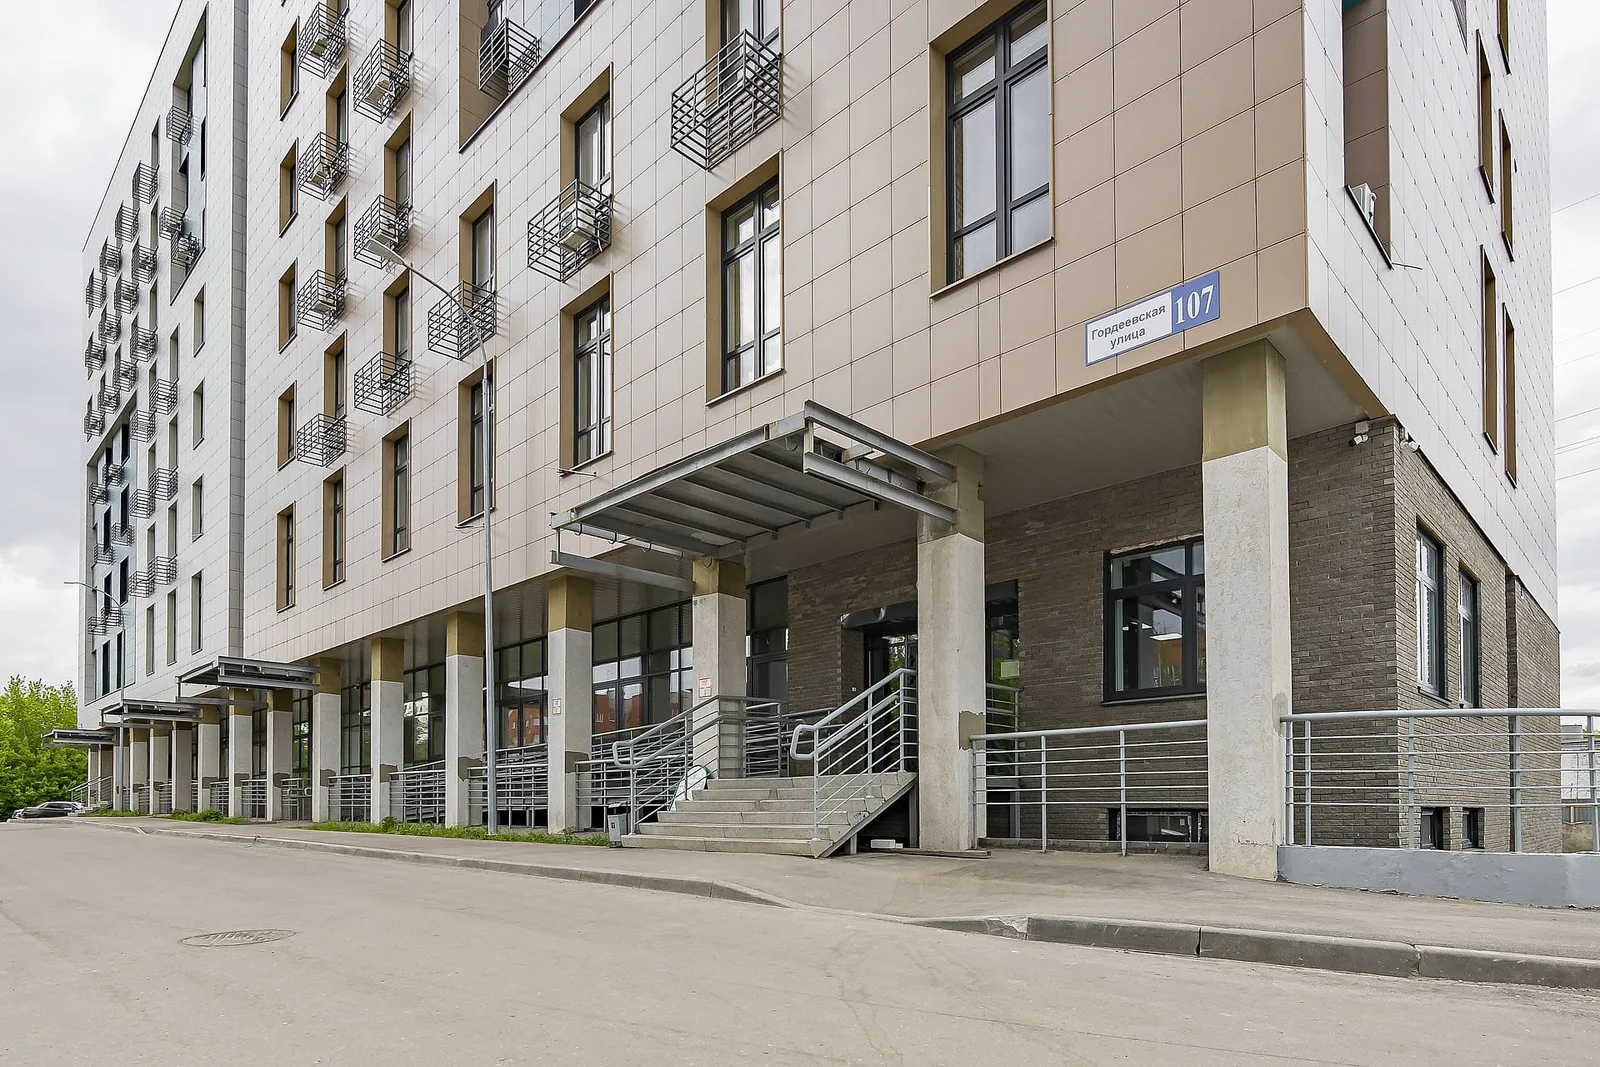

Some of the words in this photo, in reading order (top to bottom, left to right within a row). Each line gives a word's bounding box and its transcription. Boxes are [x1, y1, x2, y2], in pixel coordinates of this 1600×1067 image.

[1174, 284, 1214, 325] 107
[1091, 305, 1166, 340] Гордеевская
[1110, 327, 1146, 350] улица
